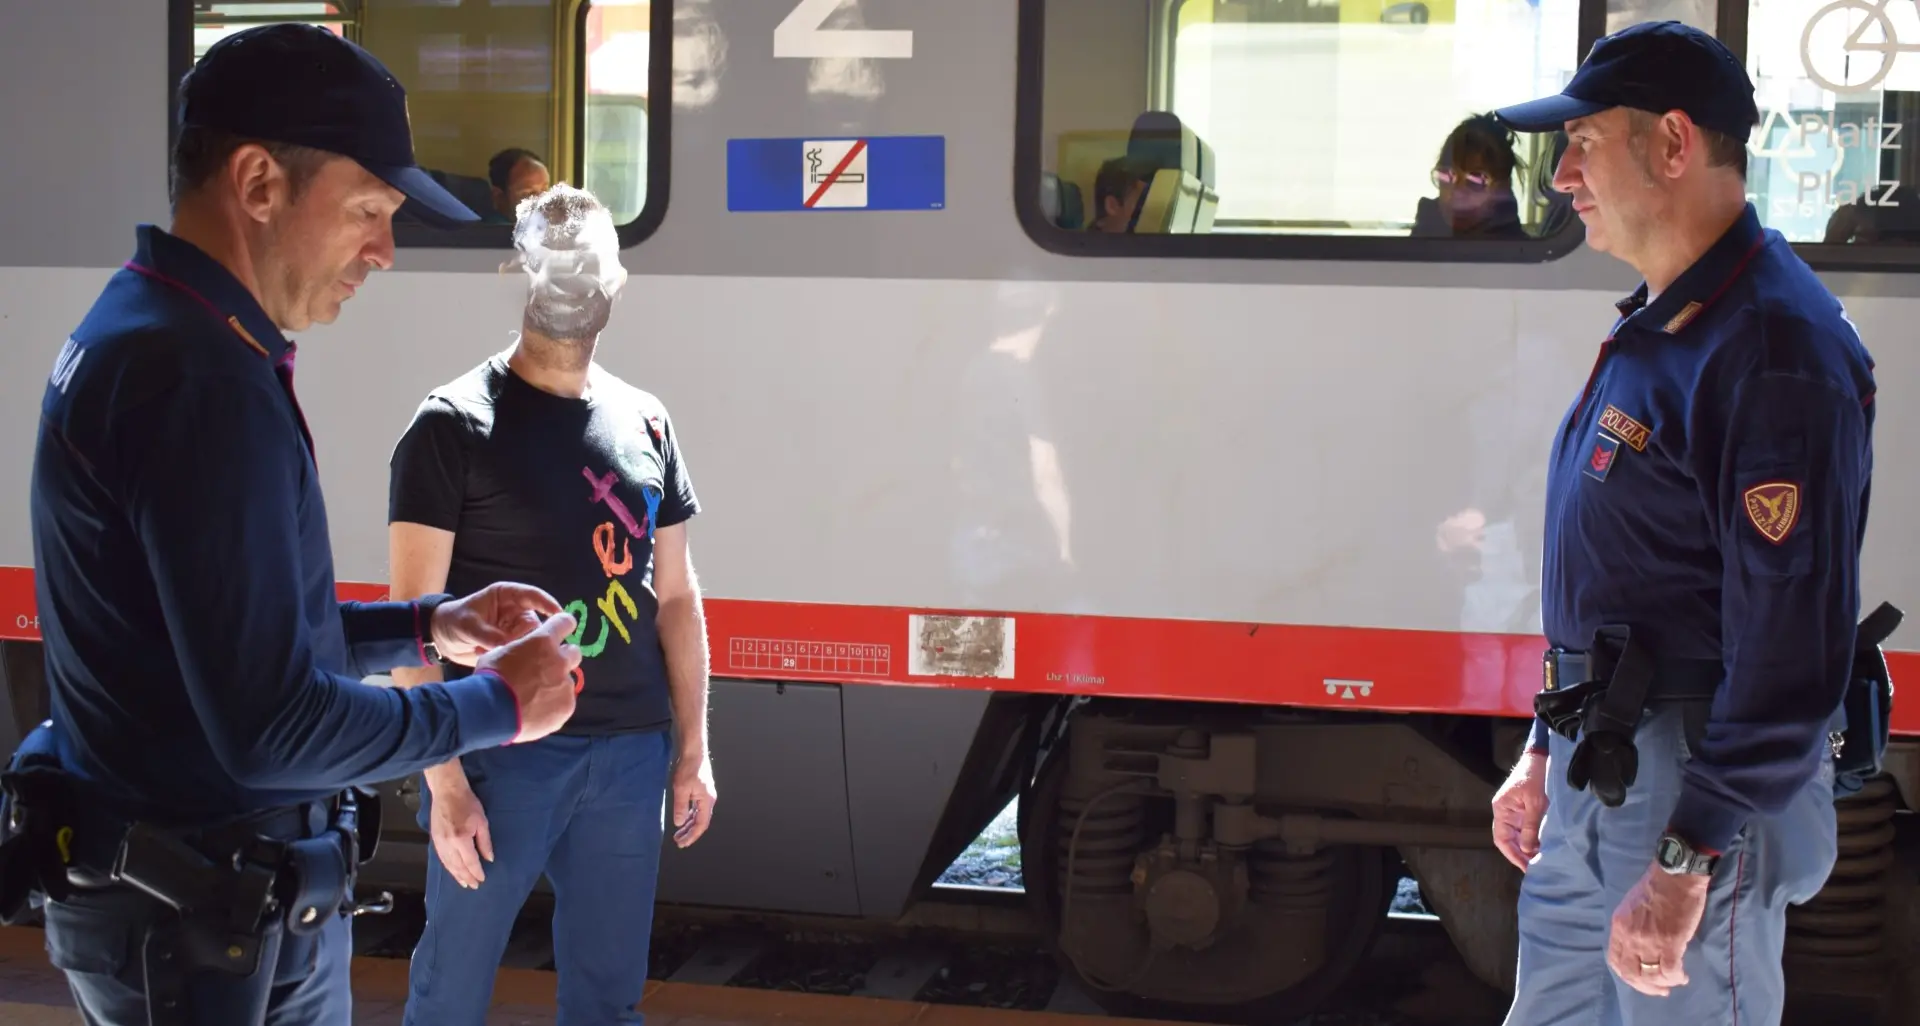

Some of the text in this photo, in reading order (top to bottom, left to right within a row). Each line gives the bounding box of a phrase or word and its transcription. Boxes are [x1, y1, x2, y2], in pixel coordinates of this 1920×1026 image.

[1799, 110, 1903, 149] Platz
[1797, 169, 1900, 207] Platz
[1601, 408, 1646, 447] POLIZIA
[1749, 497, 1773, 533] POLIZIA
[735, 642, 888, 657] 1 2 3 4 5 6 7 8 9 10 11 12
[783, 657, 796, 667] 29
